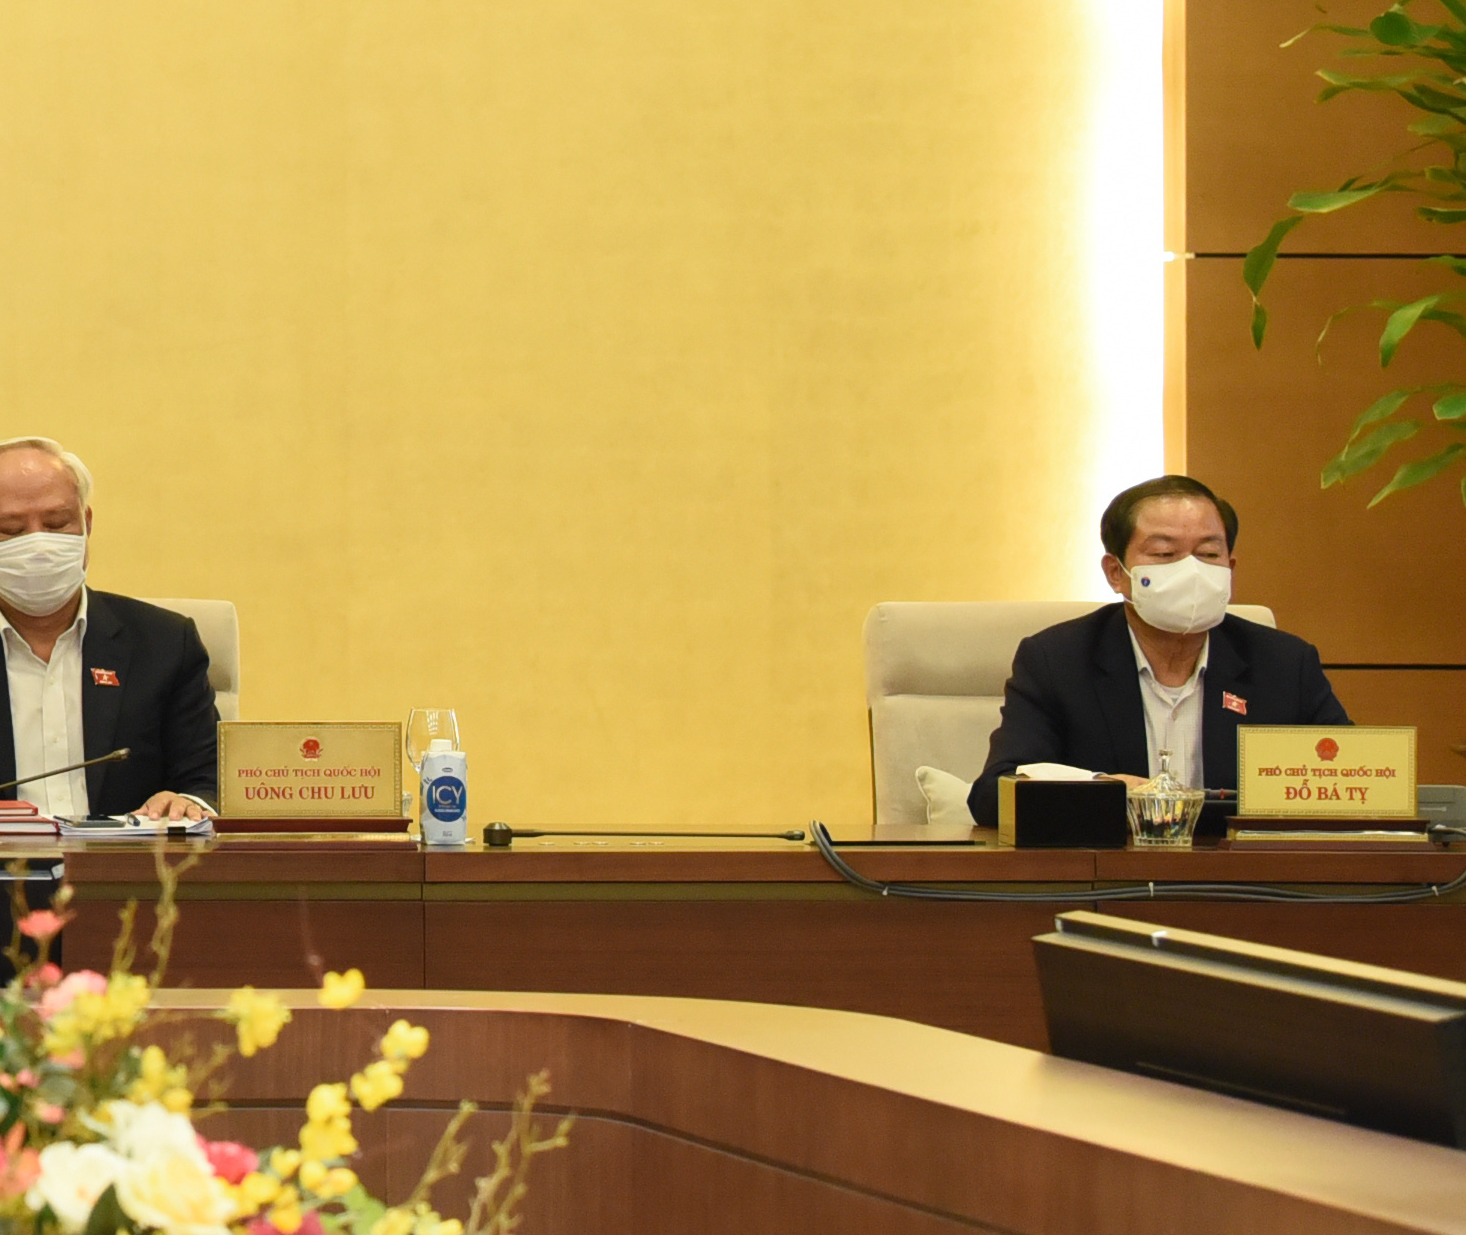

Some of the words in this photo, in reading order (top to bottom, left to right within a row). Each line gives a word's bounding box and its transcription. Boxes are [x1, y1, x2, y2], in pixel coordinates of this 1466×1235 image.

[237, 767, 262, 778] PHÓ
[265, 766, 289, 778] CHỦ
[292, 768, 320, 779] TỊCH
[323, 766, 357, 777] QUỐC
[359, 766, 381, 778] HỘI
[1258, 765, 1282, 776] PHÓ
[1284, 764, 1308, 776] CHỦ
[1311, 768, 1338, 779] TỊCH
[1340, 765, 1372, 777] QUỐC
[1375, 767, 1396, 779] HỘI
[244, 782, 293, 800] UÔNG
[298, 786, 335, 800] CHU
[340, 784, 375, 800] LƯU
[432, 785, 463, 804] ICY
[1284, 779, 1312, 801] ĐỖ
[1316, 783, 1342, 801] BÁ
[1345, 787, 1369, 804] TỴ
